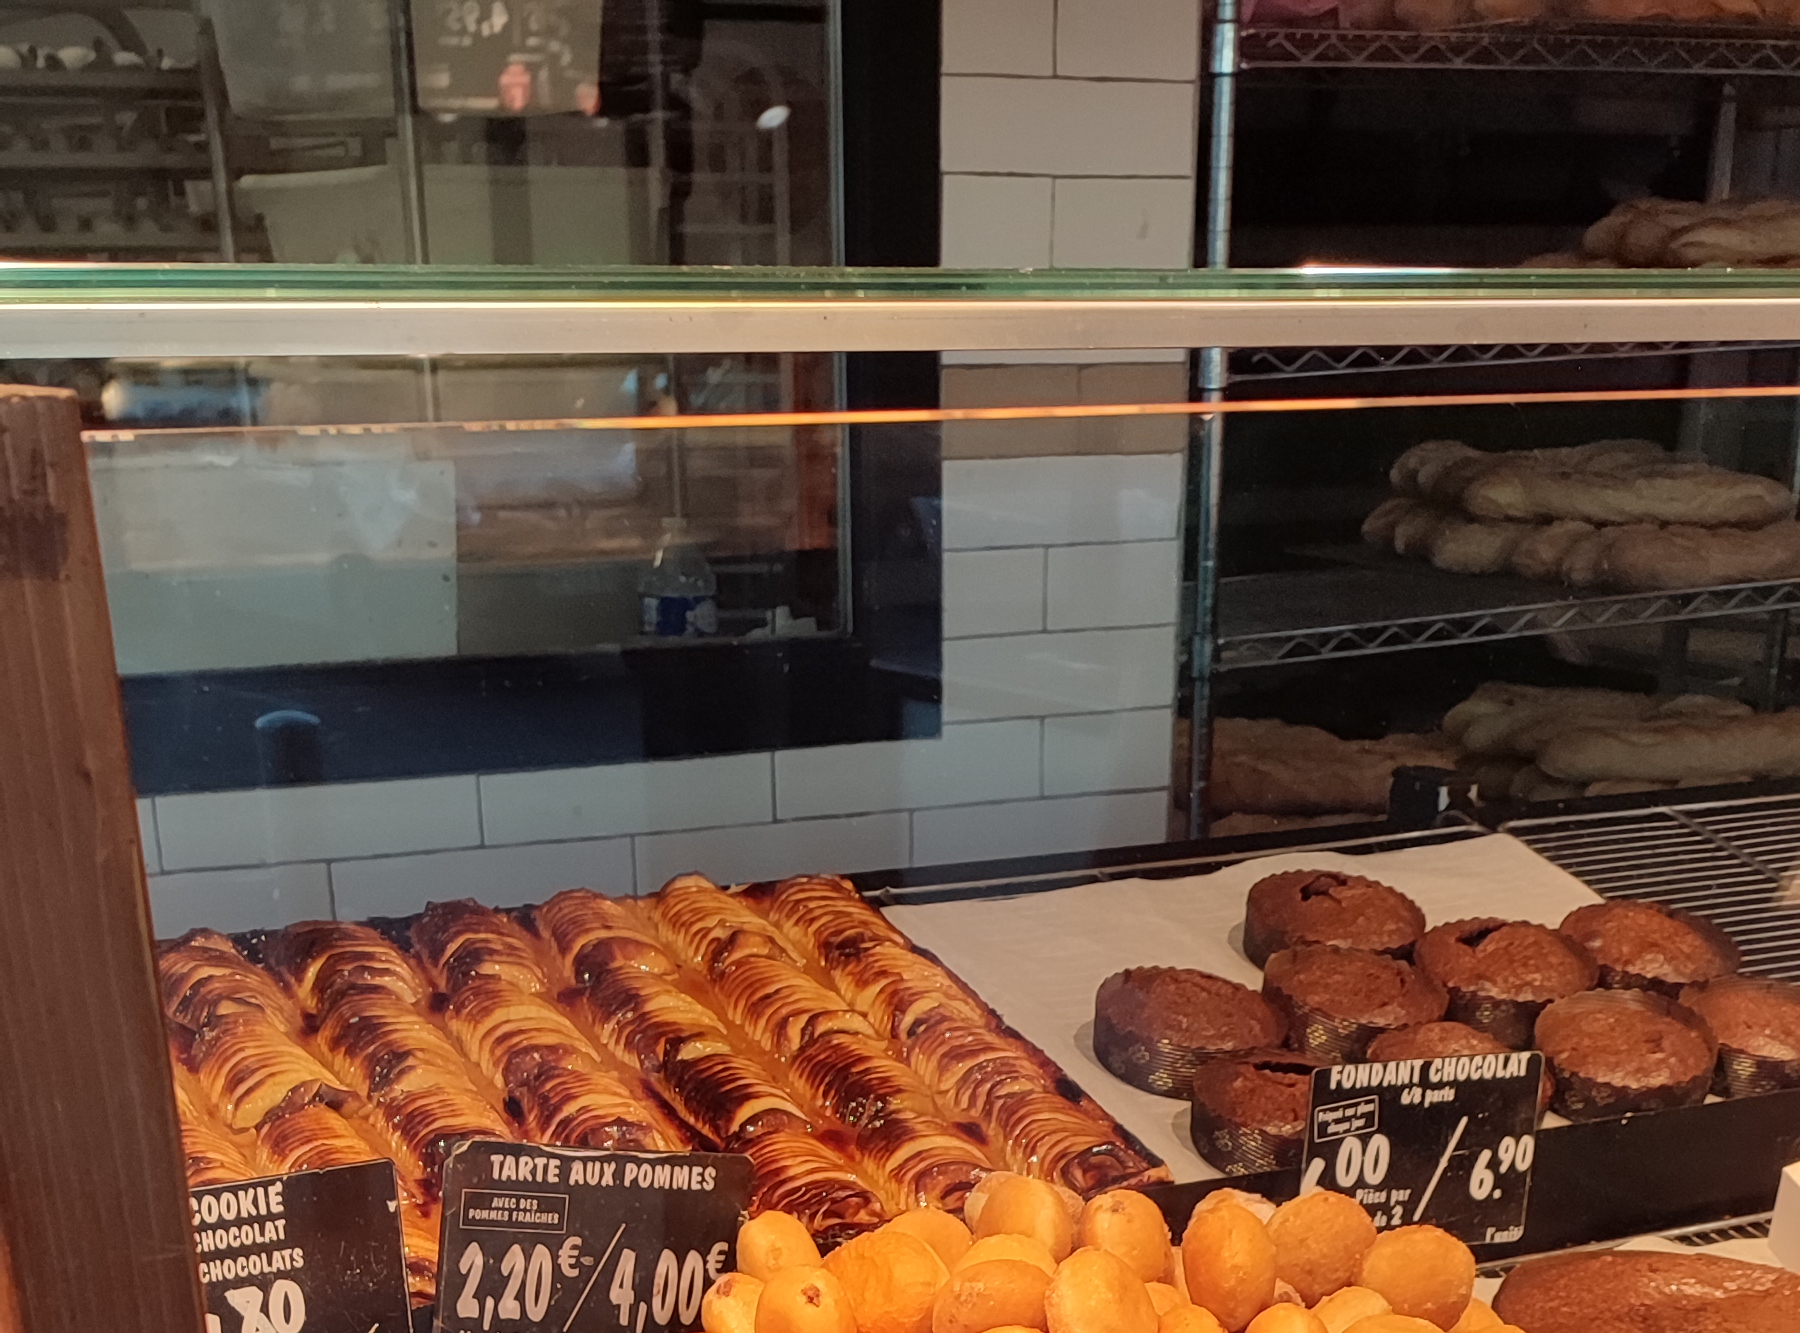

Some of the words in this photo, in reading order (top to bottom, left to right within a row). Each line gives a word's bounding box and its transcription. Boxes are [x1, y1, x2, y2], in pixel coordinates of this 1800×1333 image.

[1329, 1059, 1424, 1091] FONDANT
[1429, 1052, 1532, 1084] CHOCOLAT
[490, 1154, 561, 1184] TARTE
[569, 1160, 617, 1187] AUX
[624, 1162, 717, 1191] POMMES
[468, 1208, 510, 1222] POMMES
[491, 1197, 517, 1209] AVEC
[519, 1198, 539, 1210] DES
[1390, 1205, 1404, 1226] 2
[197, 1248, 305, 1284] CHOCOLATS
